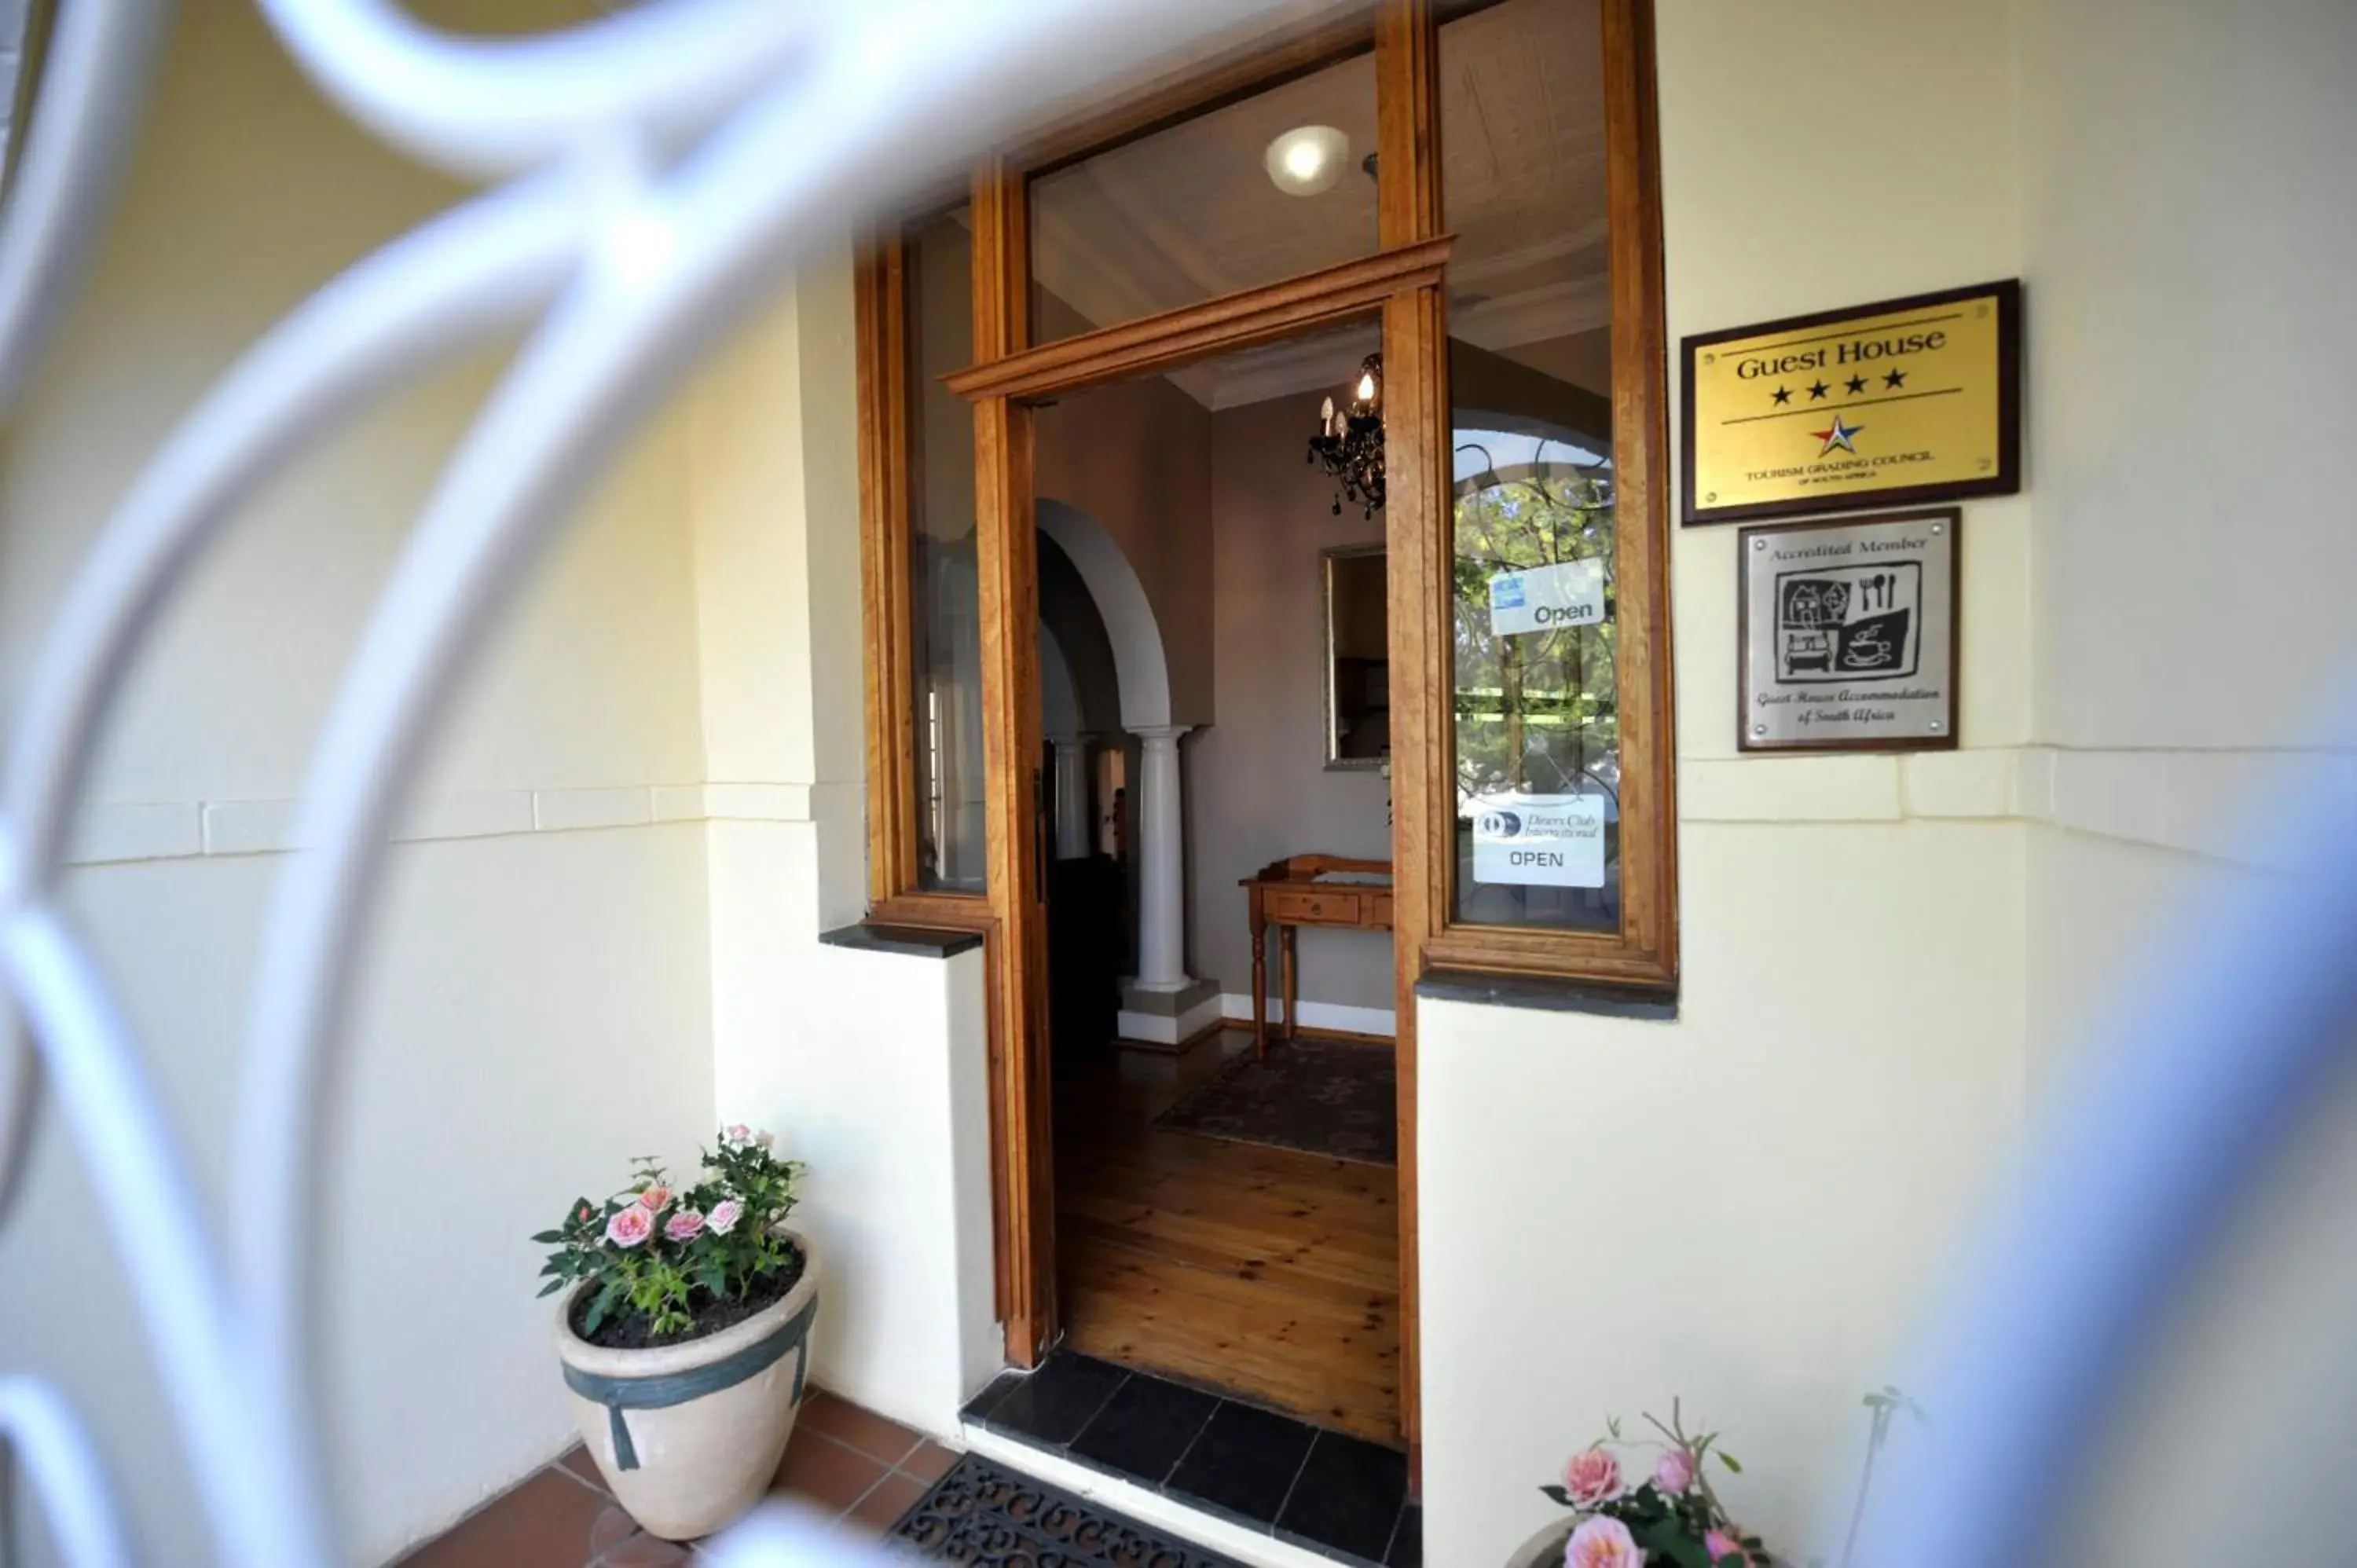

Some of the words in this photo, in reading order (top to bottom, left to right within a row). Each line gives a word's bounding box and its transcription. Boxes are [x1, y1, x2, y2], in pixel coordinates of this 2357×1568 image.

[1737, 348, 1827, 380] Guest
[1837, 331, 1947, 365] House
[1747, 466, 1804, 481] TOURISM
[1809, 459, 1869, 474] GRADING
[1872, 451, 1935, 467] COUNCIL
[1770, 540, 1853, 561] Accredited
[1860, 537, 1929, 554] Member
[1534, 603, 1593, 625] Open
[1758, 693, 1792, 708] Guest
[1838, 688, 1941, 702] Accommodation
[1510, 851, 1564, 867] OPEN
